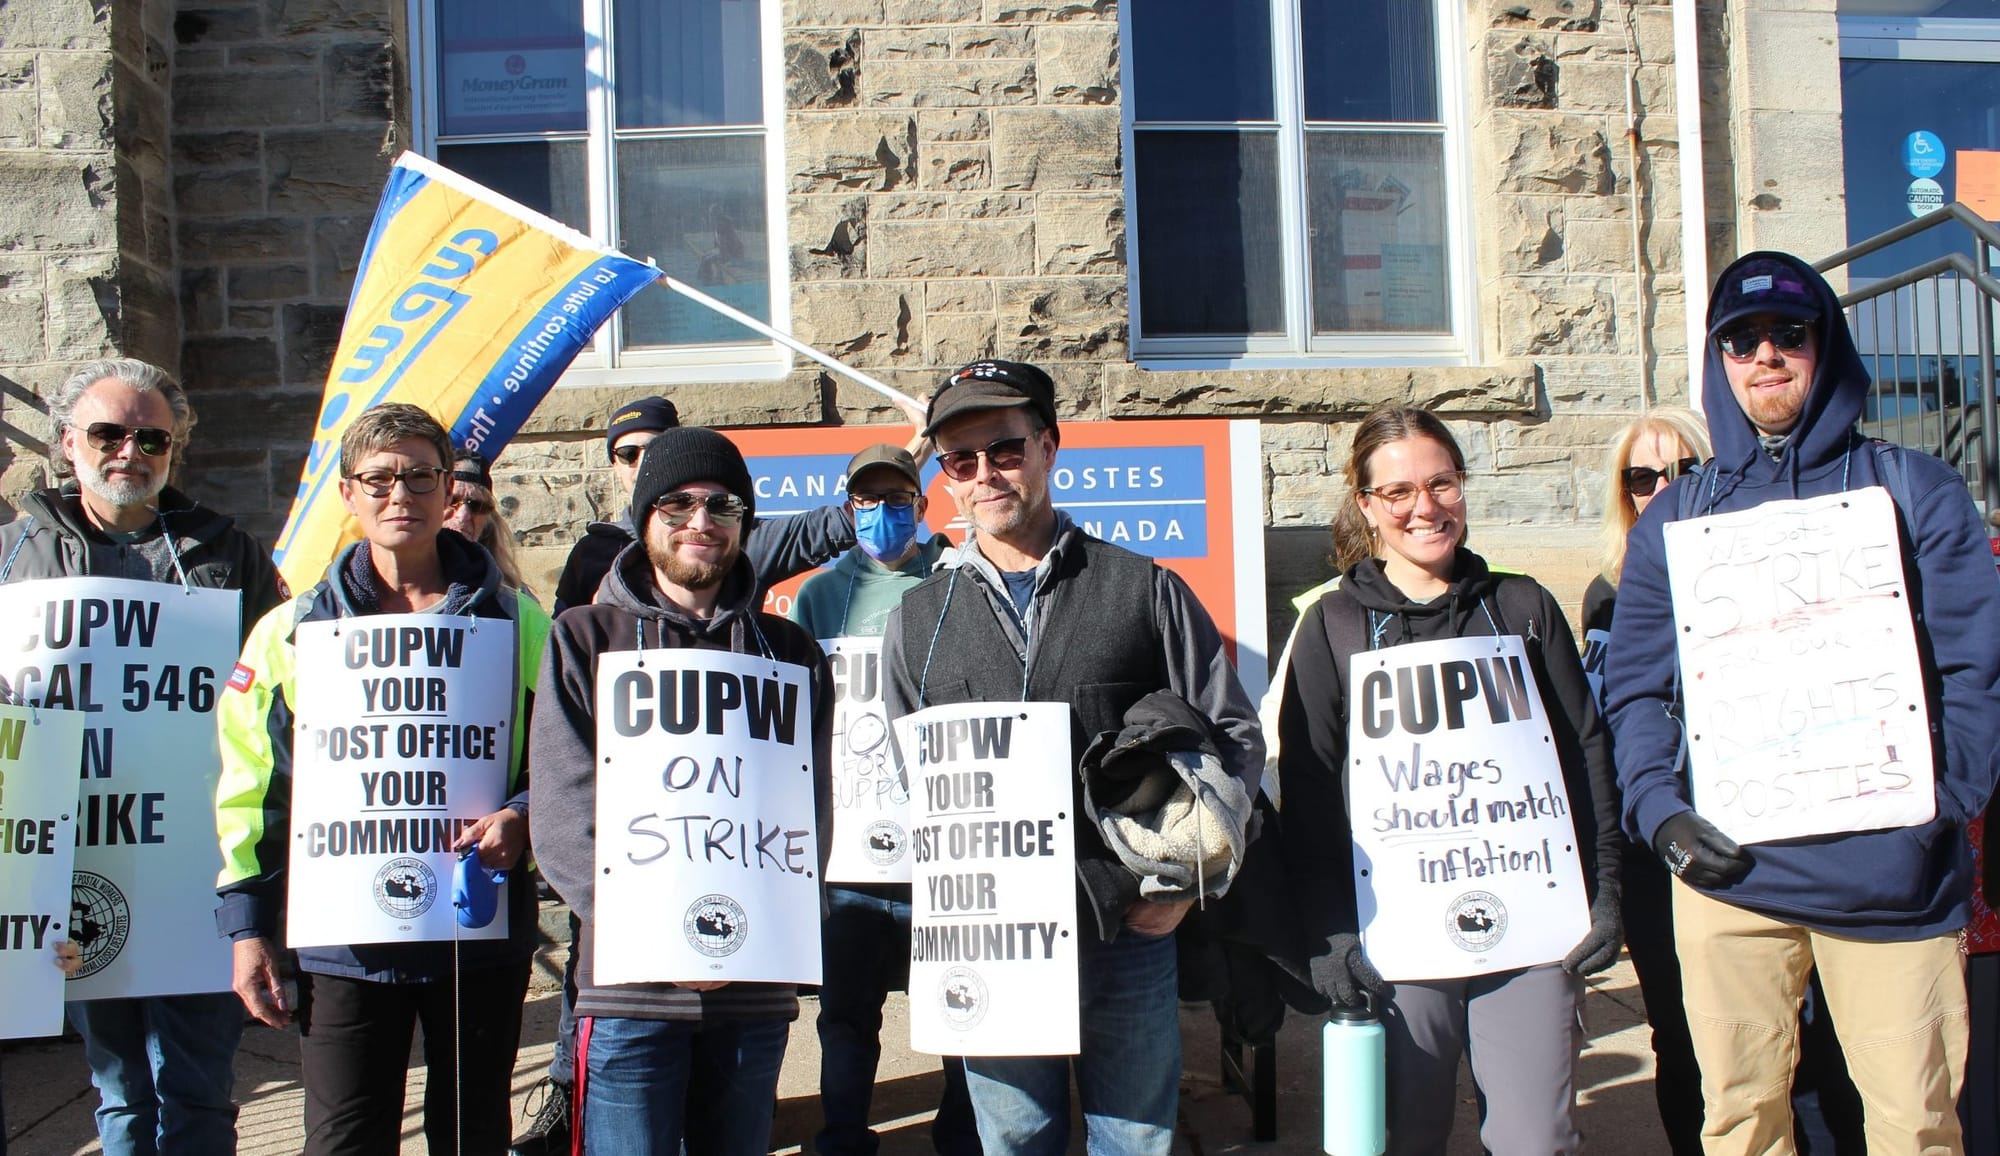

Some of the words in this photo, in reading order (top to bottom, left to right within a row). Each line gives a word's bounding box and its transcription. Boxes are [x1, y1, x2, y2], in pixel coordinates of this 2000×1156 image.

[461, 75, 568, 93] MoneyGram
[1908, 195, 1942, 203] CAUTION
[754, 474, 849, 498] CANA
[1053, 466, 1164, 490] OSTES
[1083, 519, 1185, 543] NADA
[1694, 544, 1900, 639] STRIKE
[344, 627, 465, 670] CUPW
[14, 662, 104, 713] CAL
[122, 663, 216, 713] 546
[361, 677, 447, 713] YOUR
[826, 653, 885, 703] CU
[1362, 655, 1533, 739] CUPW
[613, 669, 799, 746] CUPW
[1708, 671, 1901, 761] RIGHTS
[80, 727, 114, 780] N
[313, 724, 389, 762] POST
[396, 723, 497, 761] OFFICE
[662, 755, 743, 799] ON
[842, 753, 889, 778] FOR
[1378, 742, 1503, 799] Wages
[360, 771, 448, 807] YOUR
[832, 775, 910, 811] SUPPO
[925, 771, 994, 812] YOUR
[1372, 797, 1480, 833] should
[1486, 781, 1567, 824] match
[1713, 759, 1914, 819] POSTIES
[75, 792, 165, 848] IKE
[306, 818, 479, 859] COMMUNI
[949, 820, 1055, 861] OFFICE
[78, 874, 99, 890] POSTAL
[1417, 837, 1557, 889] inflation!
[928, 872, 997, 912] YOUR
